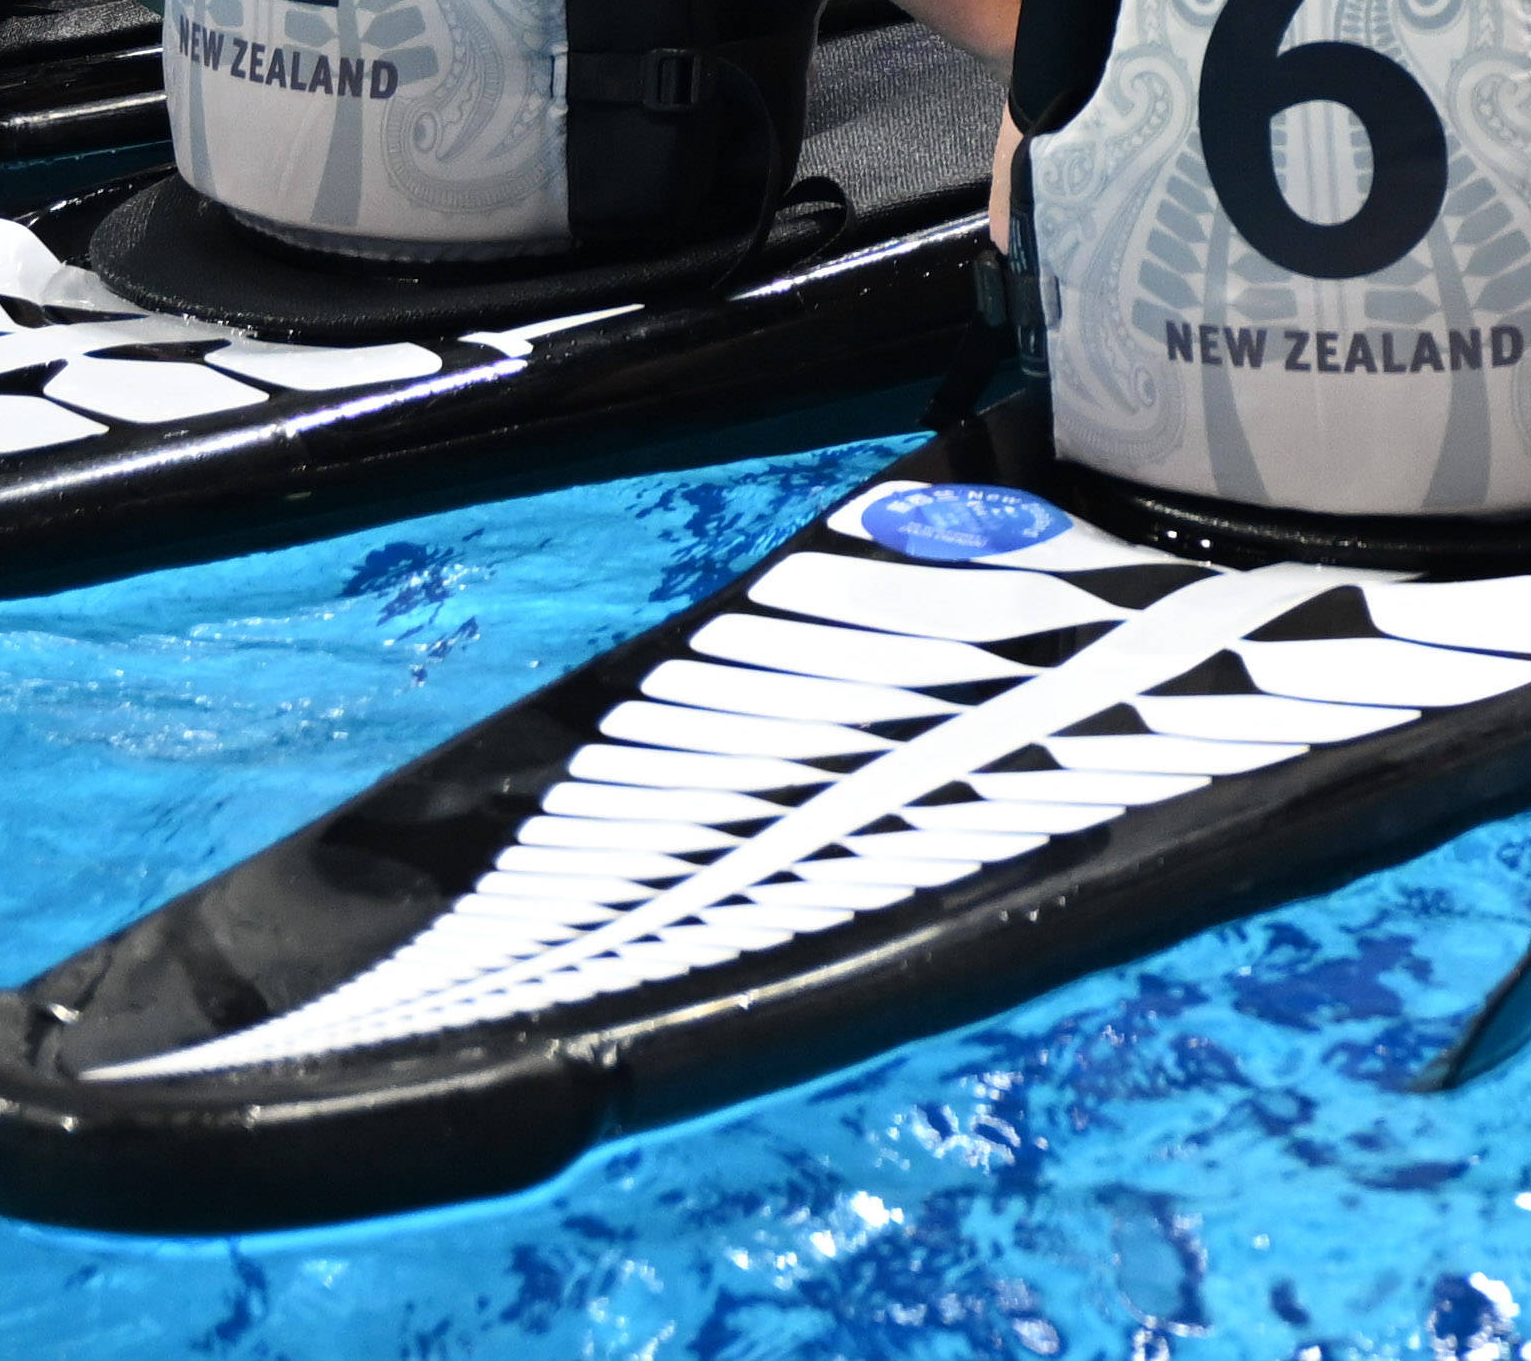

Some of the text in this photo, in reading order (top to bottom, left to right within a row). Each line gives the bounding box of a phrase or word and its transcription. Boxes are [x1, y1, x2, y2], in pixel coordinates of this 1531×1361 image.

[176, 18, 400, 101] NEW ZEALAND
[1165, 318, 1527, 372] NEW ZEALAND
